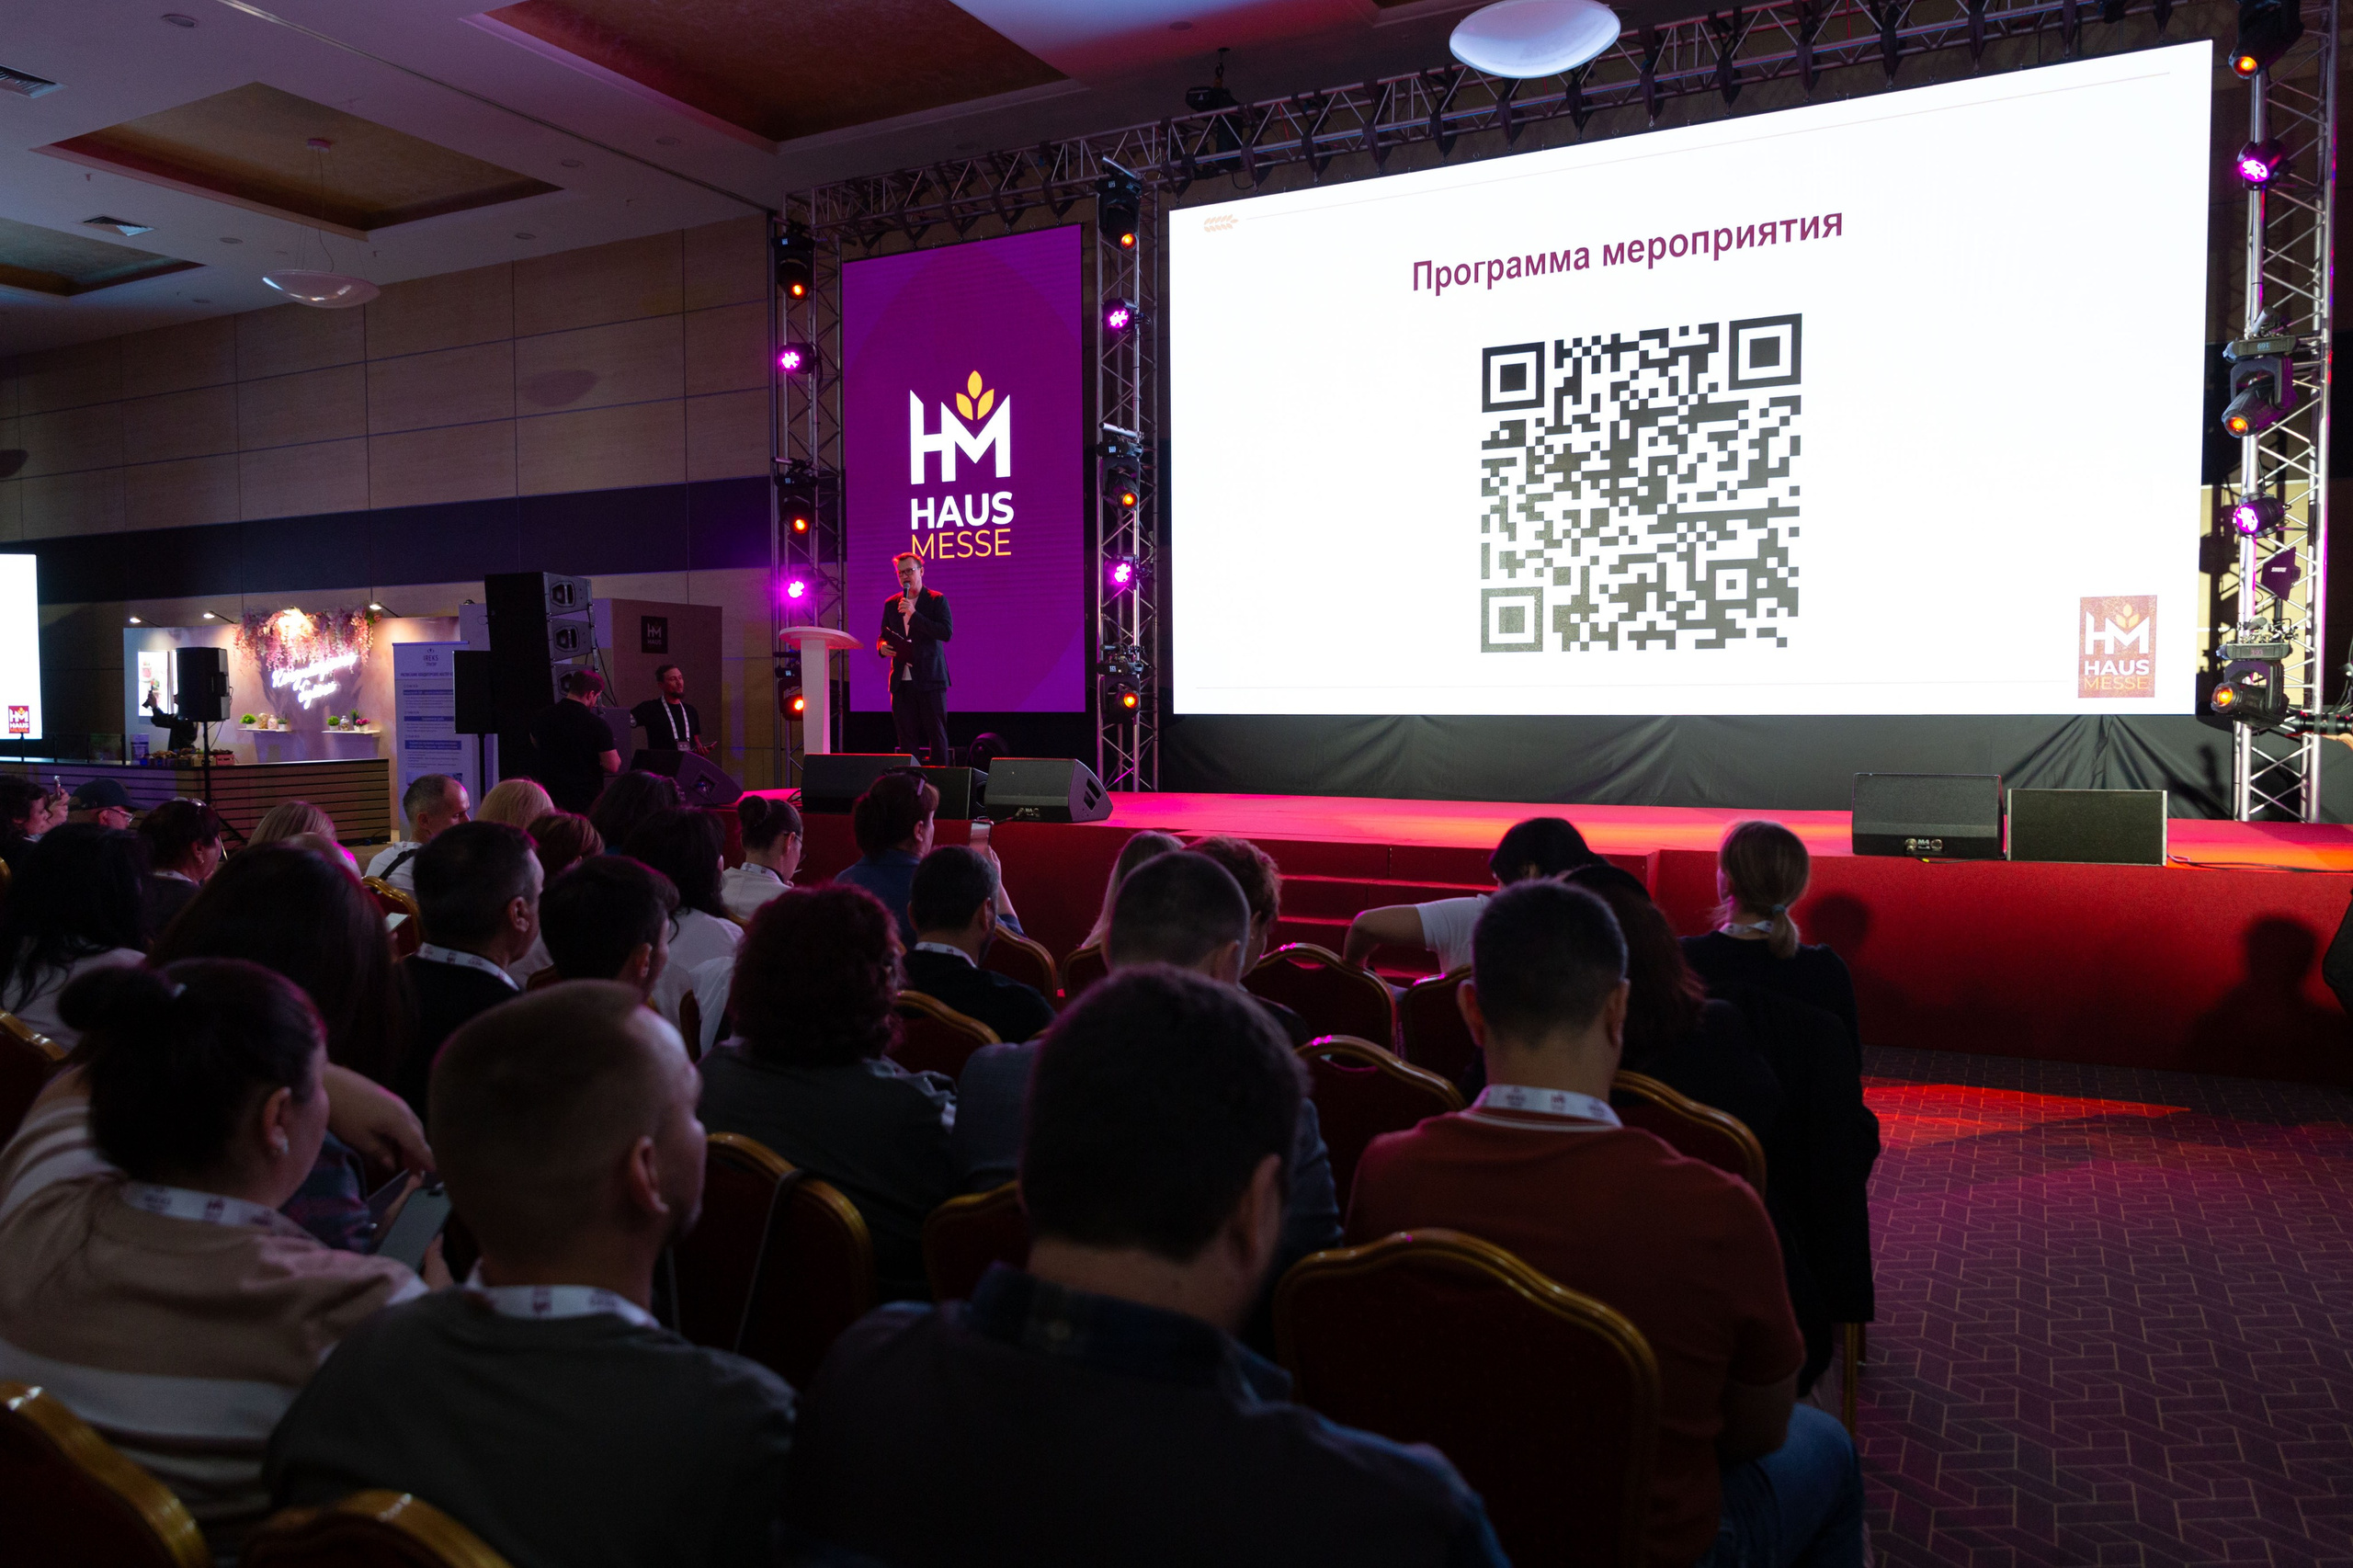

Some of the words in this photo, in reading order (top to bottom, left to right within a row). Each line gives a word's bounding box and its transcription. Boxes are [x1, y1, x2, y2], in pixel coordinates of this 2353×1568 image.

[1414, 247, 1589, 296] Программа
[1603, 212, 1842, 269] мероприятия
[909, 389, 1011, 485] HM
[911, 491, 1015, 530] HAUS
[911, 528, 1012, 560] MESSE
[2085, 610, 2150, 655] HM
[2084, 659, 2150, 676] HAUS
[2084, 676, 2149, 690] MESSE
